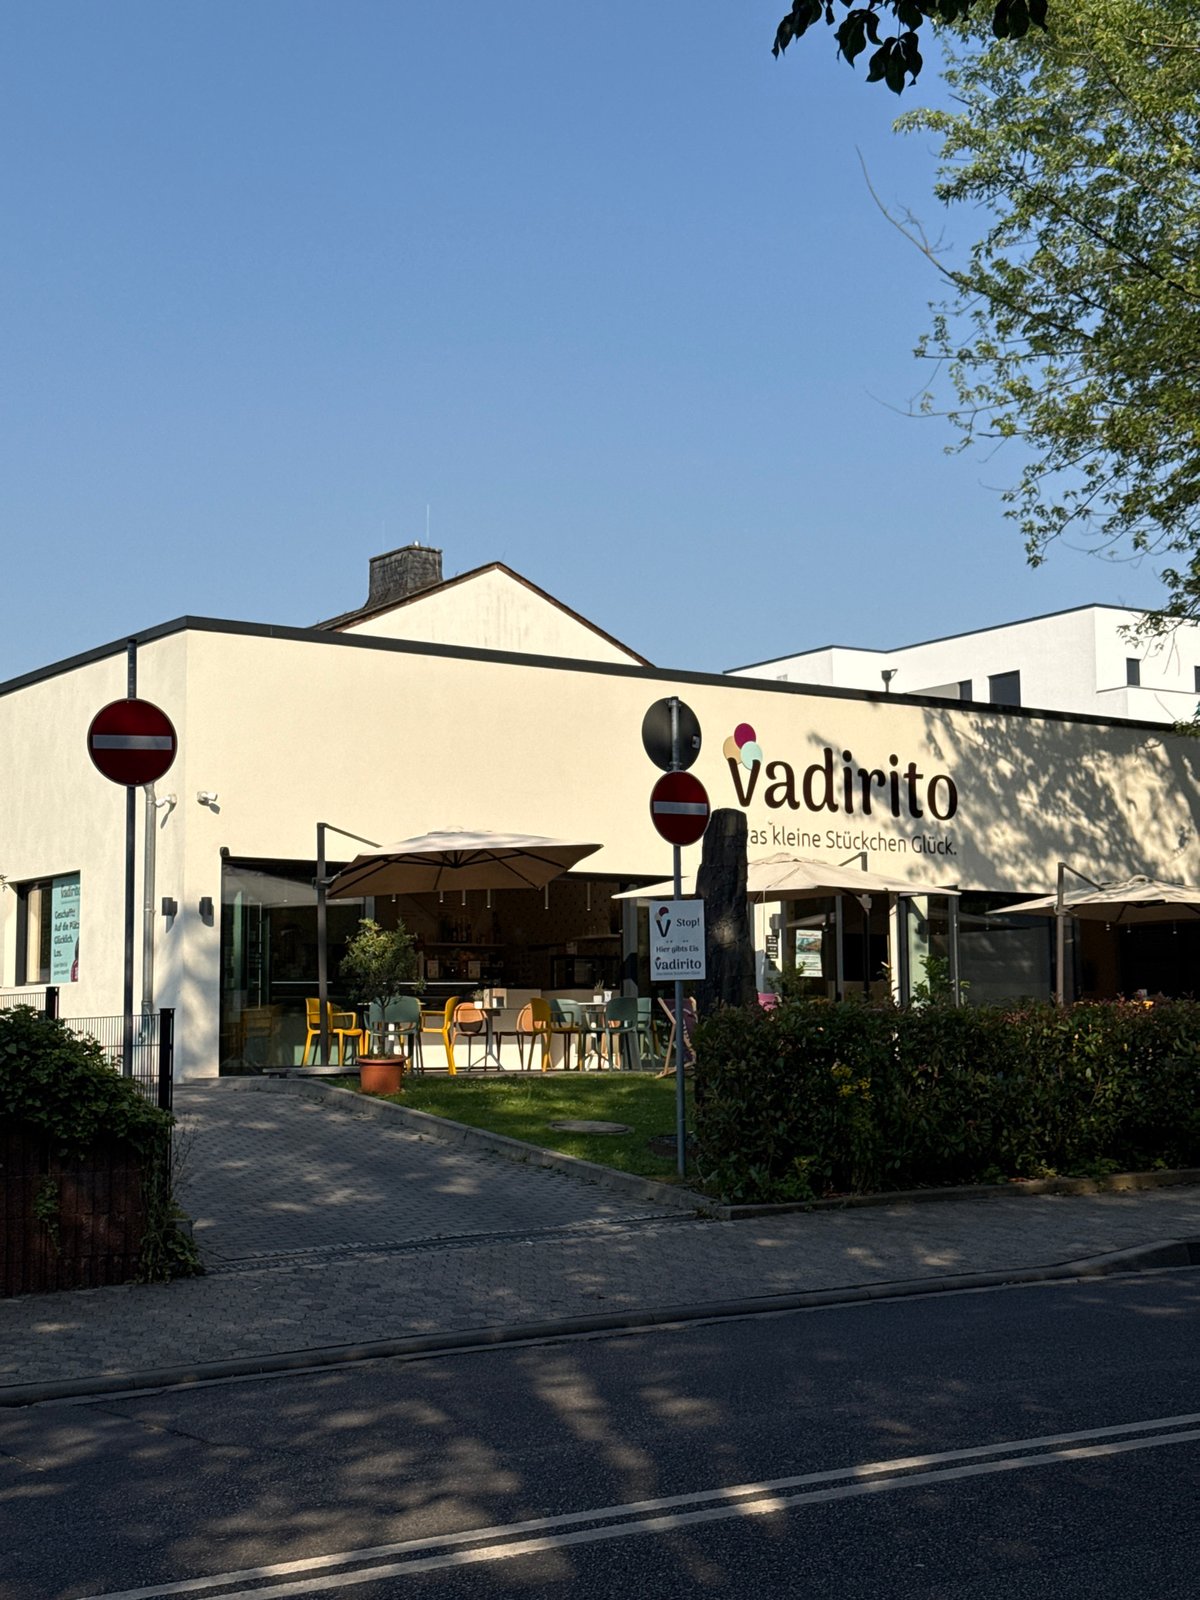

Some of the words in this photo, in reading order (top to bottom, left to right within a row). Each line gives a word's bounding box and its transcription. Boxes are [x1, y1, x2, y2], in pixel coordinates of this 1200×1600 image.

[727, 747, 958, 821] vadirito
[749, 829, 768, 845] as
[772, 825, 821, 848] kleine
[826, 829, 907, 853] Stückchen
[911, 835, 957, 856] Glück.
[676, 918, 700, 928] Stop!
[671, 945, 688, 954] gibts
[654, 958, 702, 970] vadirito
